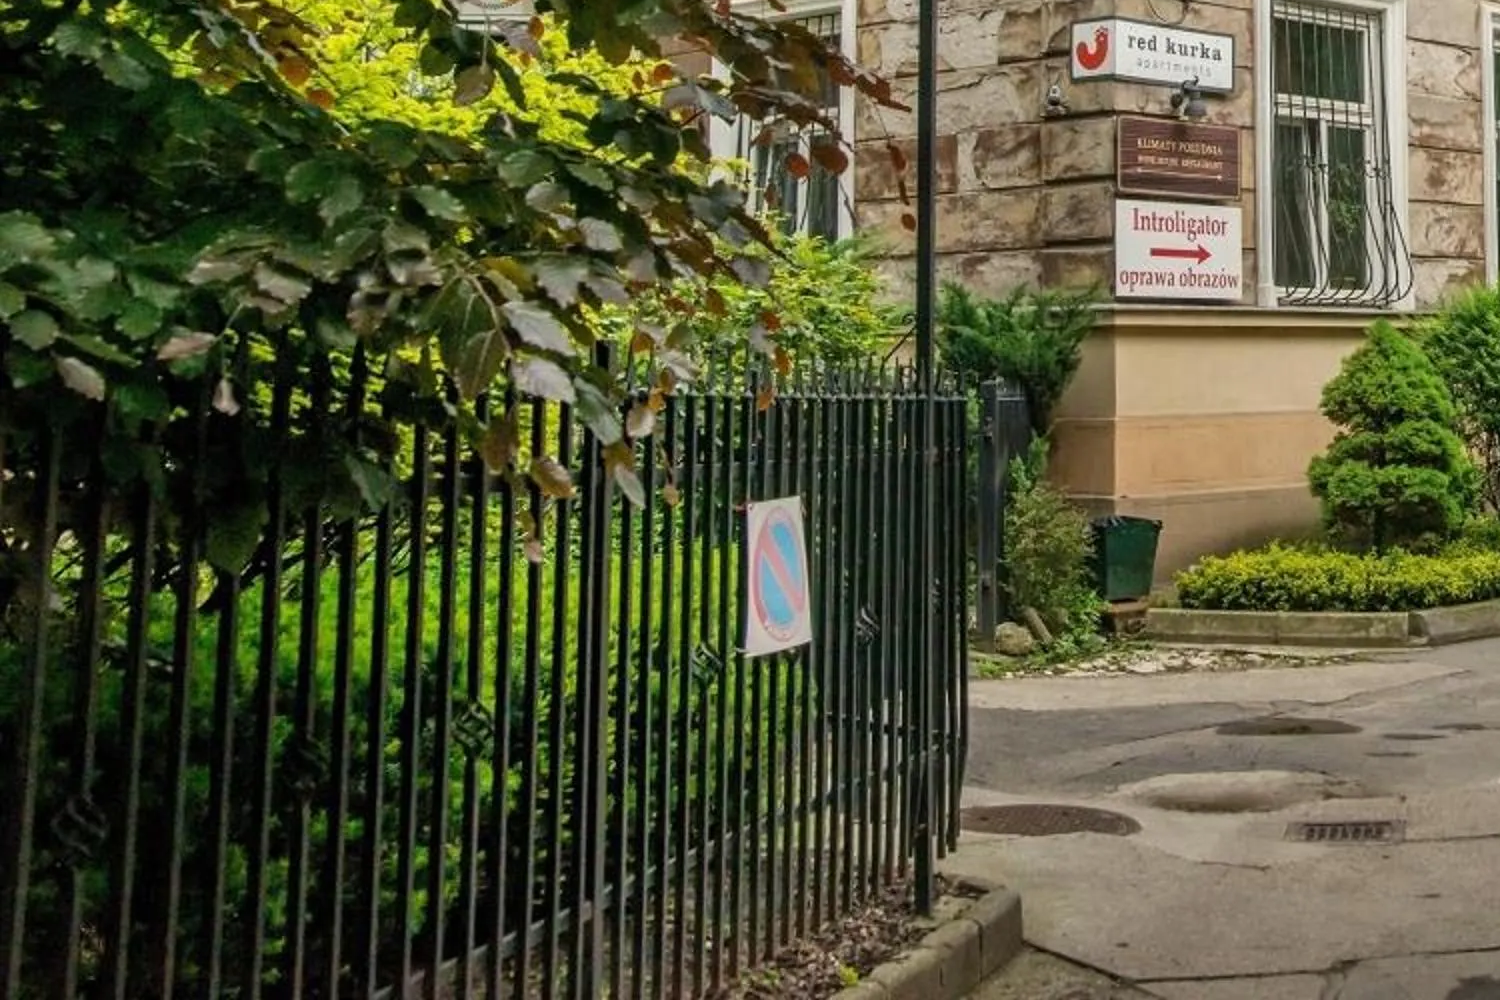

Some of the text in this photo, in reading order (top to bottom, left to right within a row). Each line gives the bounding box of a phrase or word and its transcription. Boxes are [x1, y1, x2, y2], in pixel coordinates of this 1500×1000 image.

[1127, 34, 1222, 61] red kurka
[1133, 207, 1229, 241] Introligator
[1119, 267, 1239, 291] oprawa obrazów
